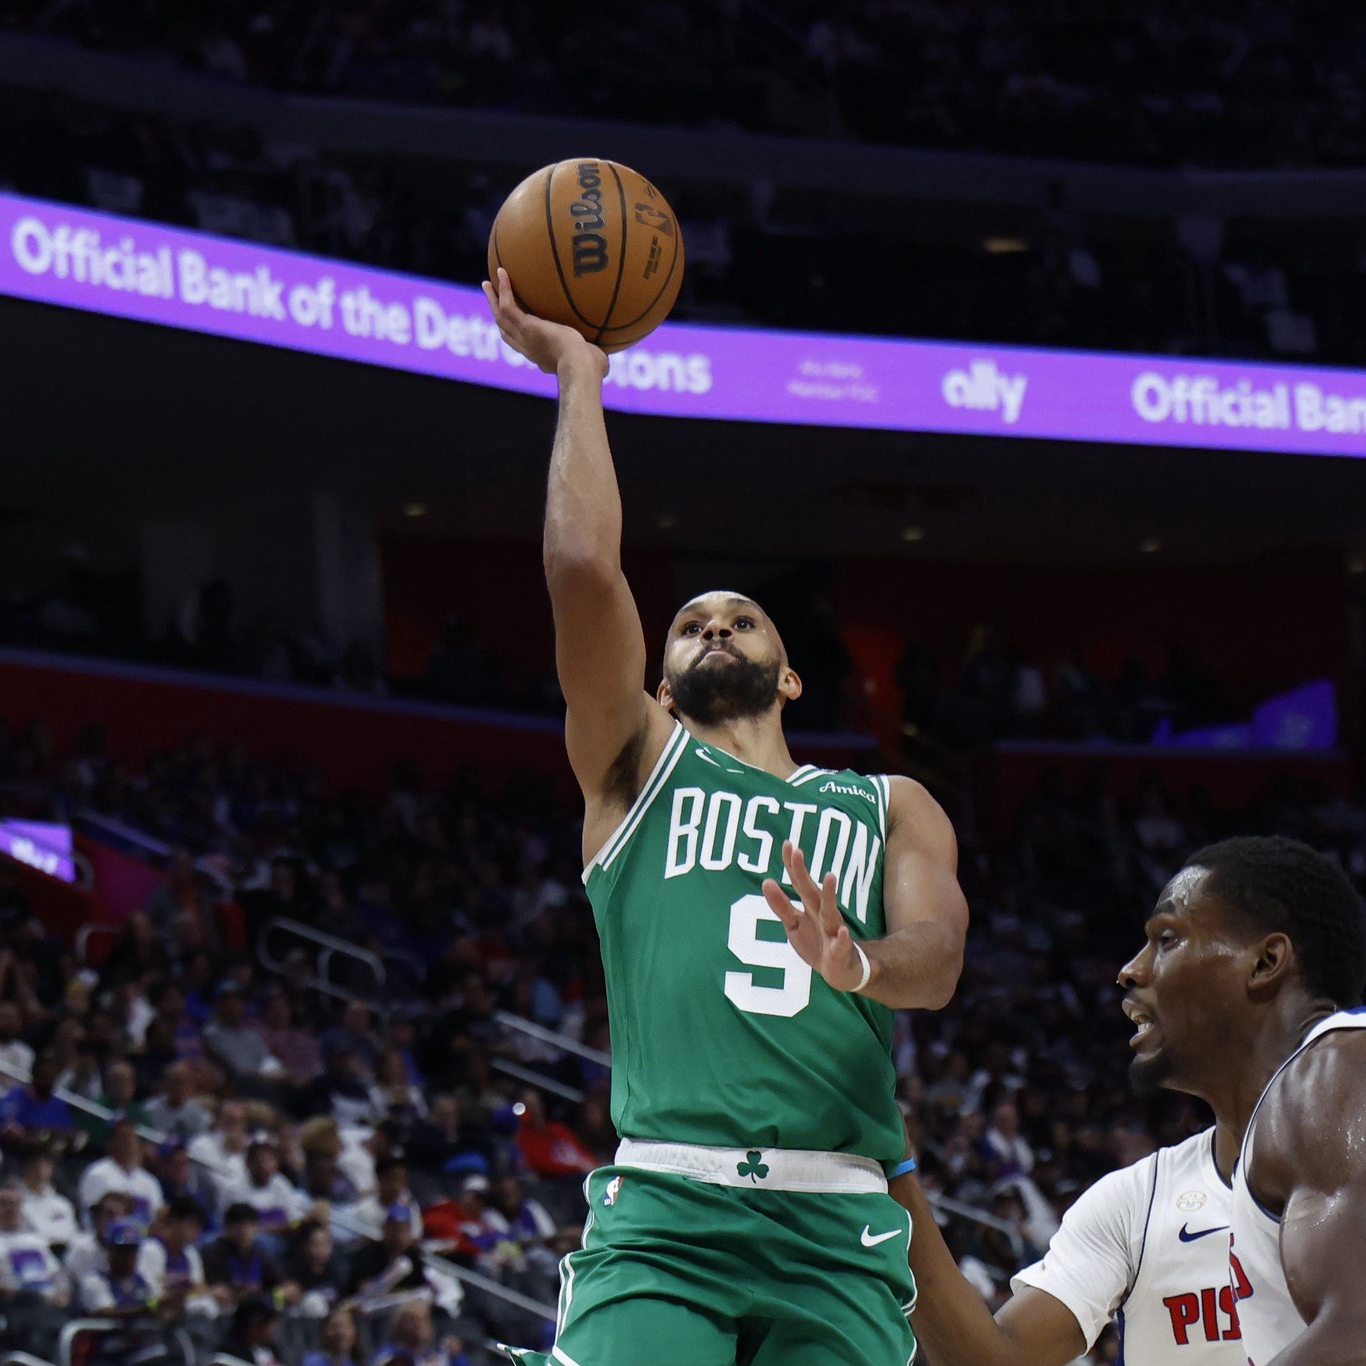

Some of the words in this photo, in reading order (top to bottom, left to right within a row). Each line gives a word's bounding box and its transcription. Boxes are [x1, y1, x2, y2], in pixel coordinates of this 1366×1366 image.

[569, 162, 609, 278] Wilson
[11, 217, 173, 298] Official
[177, 249, 287, 321] Bank
[290, 278, 336, 330] of
[340, 290, 411, 345] the
[415, 297, 540, 369] Detr
[605, 349, 712, 395] tons
[941, 359, 1027, 425] ally
[1132, 372, 1290, 429] Official
[819, 780, 877, 804] Amica
[664, 786, 881, 925] BOSTON
[724, 893, 813, 1018] 9
